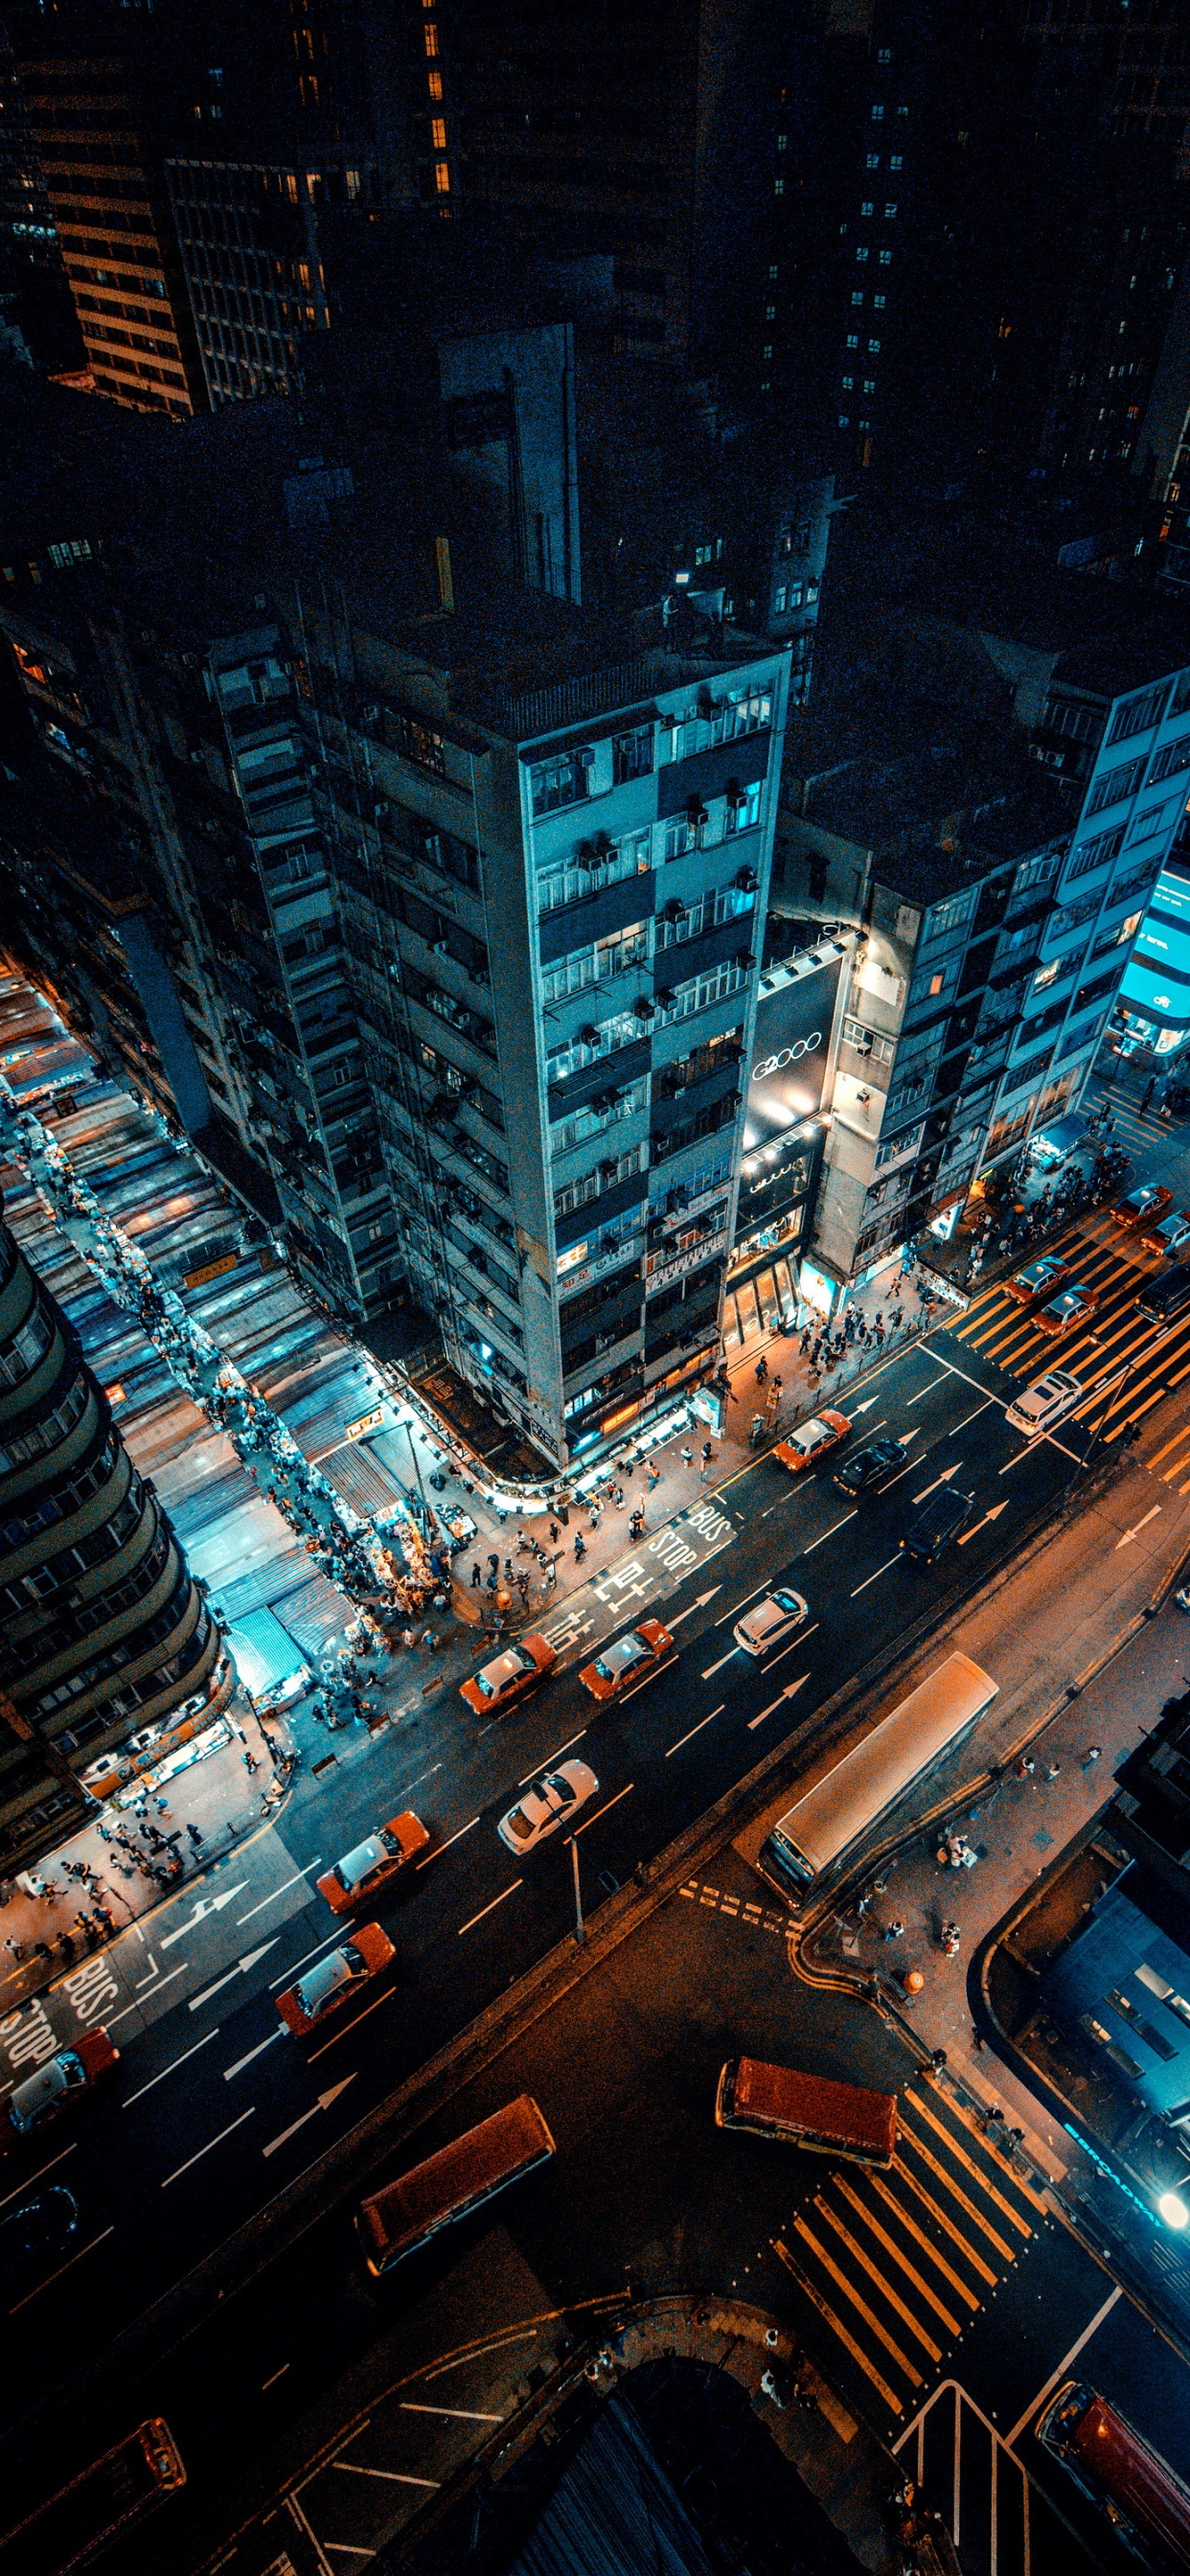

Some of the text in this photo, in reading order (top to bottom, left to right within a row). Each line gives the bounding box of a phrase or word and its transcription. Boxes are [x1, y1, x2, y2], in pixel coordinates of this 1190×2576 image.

[752, 1031, 822, 1081] G2000
[648, 1530, 698, 1572] STOP
[687, 1506, 732, 1542] BUS
[593, 1560, 655, 1615] 巴士
[63, 1956, 119, 2019] BUS
[0, 1998, 57, 2069] STOP
[1077, 2137, 1166, 2229] BROADWAY
